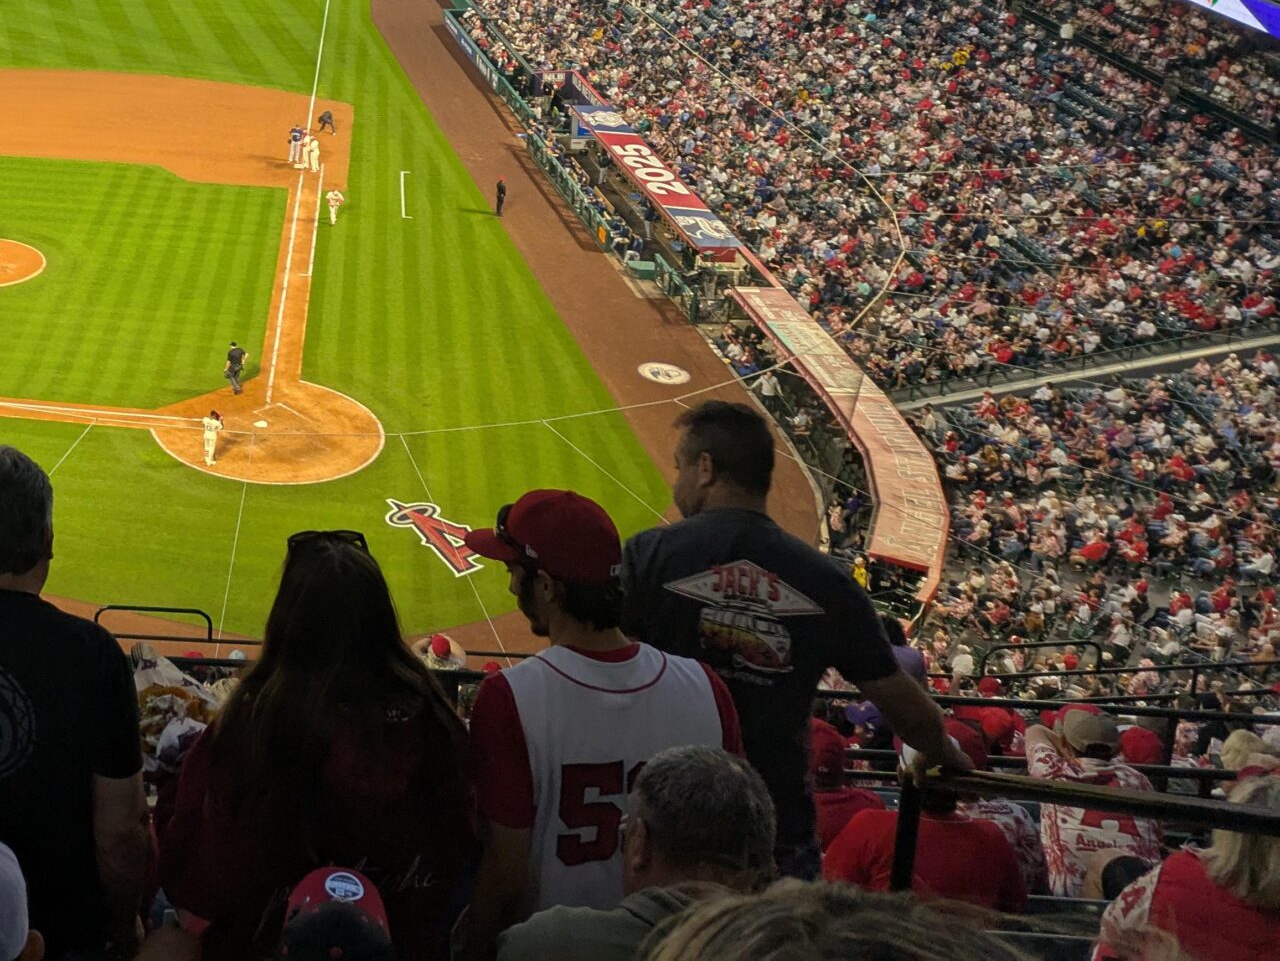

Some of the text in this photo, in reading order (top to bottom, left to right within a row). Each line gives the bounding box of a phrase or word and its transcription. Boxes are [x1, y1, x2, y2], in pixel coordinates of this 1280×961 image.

[611, 143, 691, 196] 2025
[706, 564, 782, 602] JACK'S
[555, 758, 648, 867] 5
